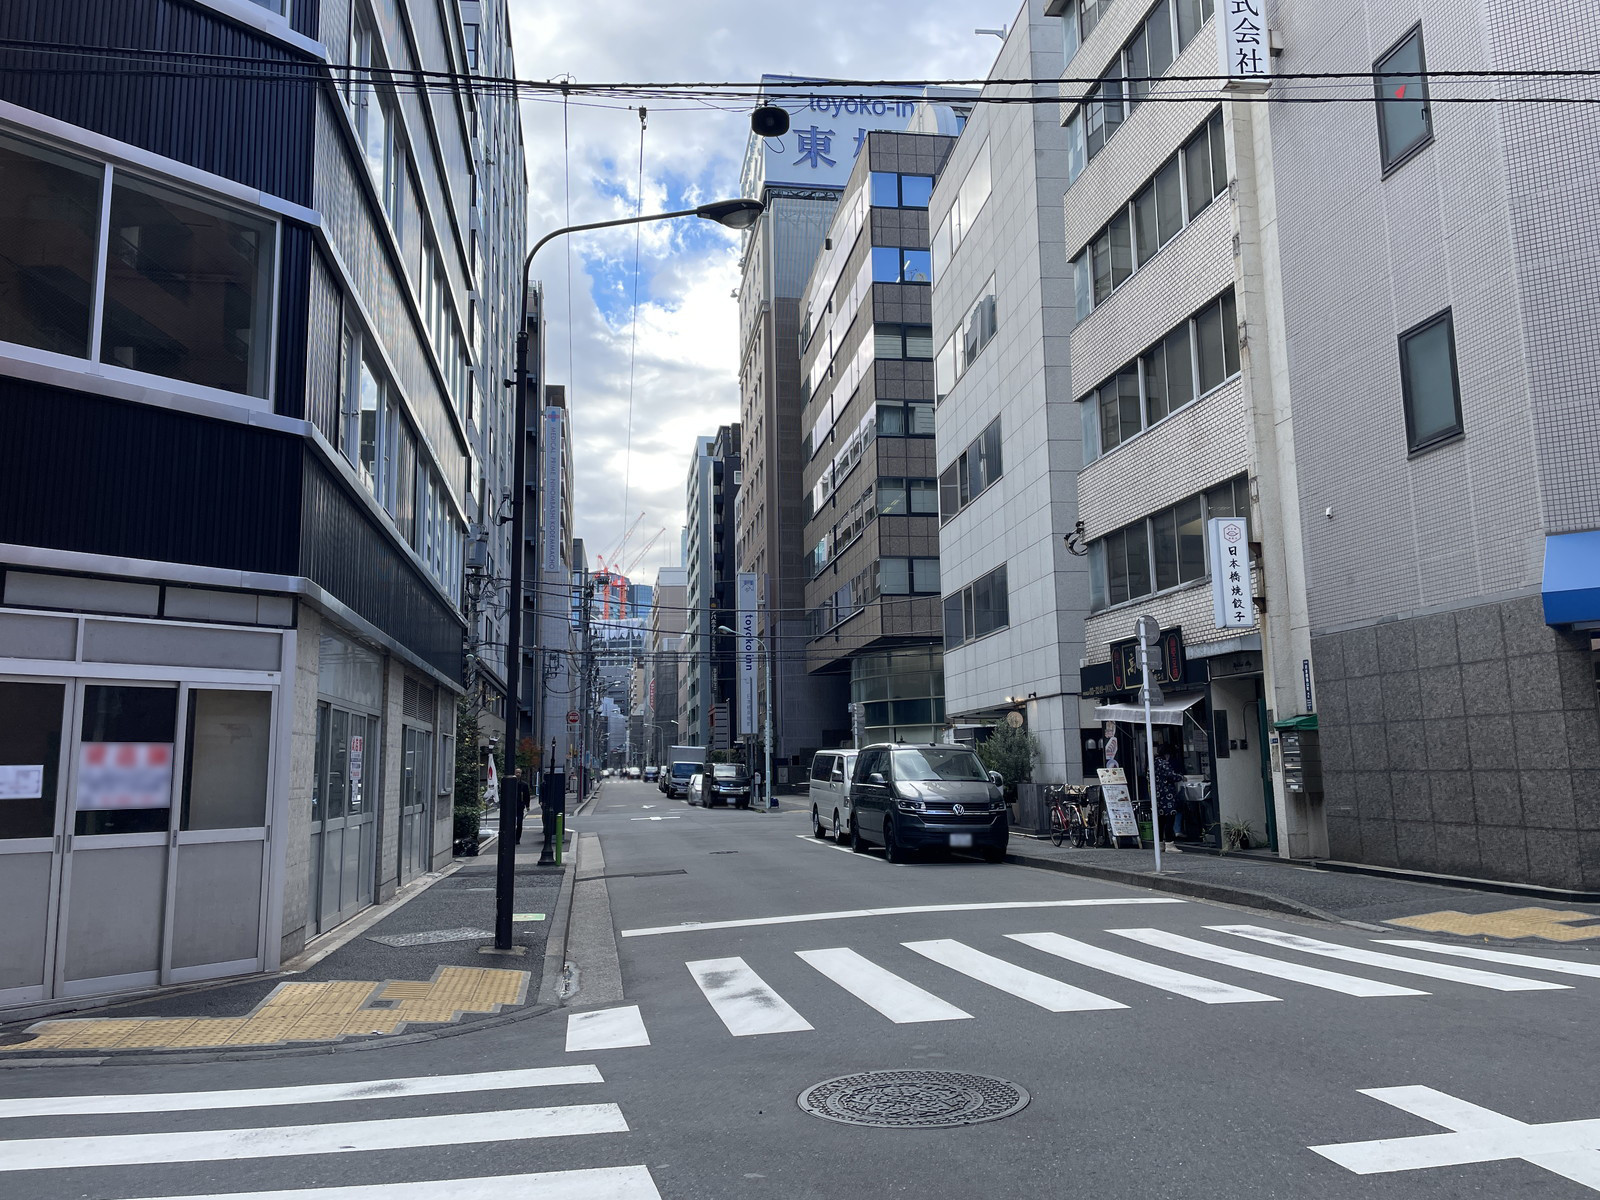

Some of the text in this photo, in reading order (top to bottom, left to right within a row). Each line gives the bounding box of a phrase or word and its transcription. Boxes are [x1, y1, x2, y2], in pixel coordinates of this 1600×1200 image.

[1231, 0, 1265, 74] 式会社
[1228, 546, 1245, 622] 日本橋焼餃子
